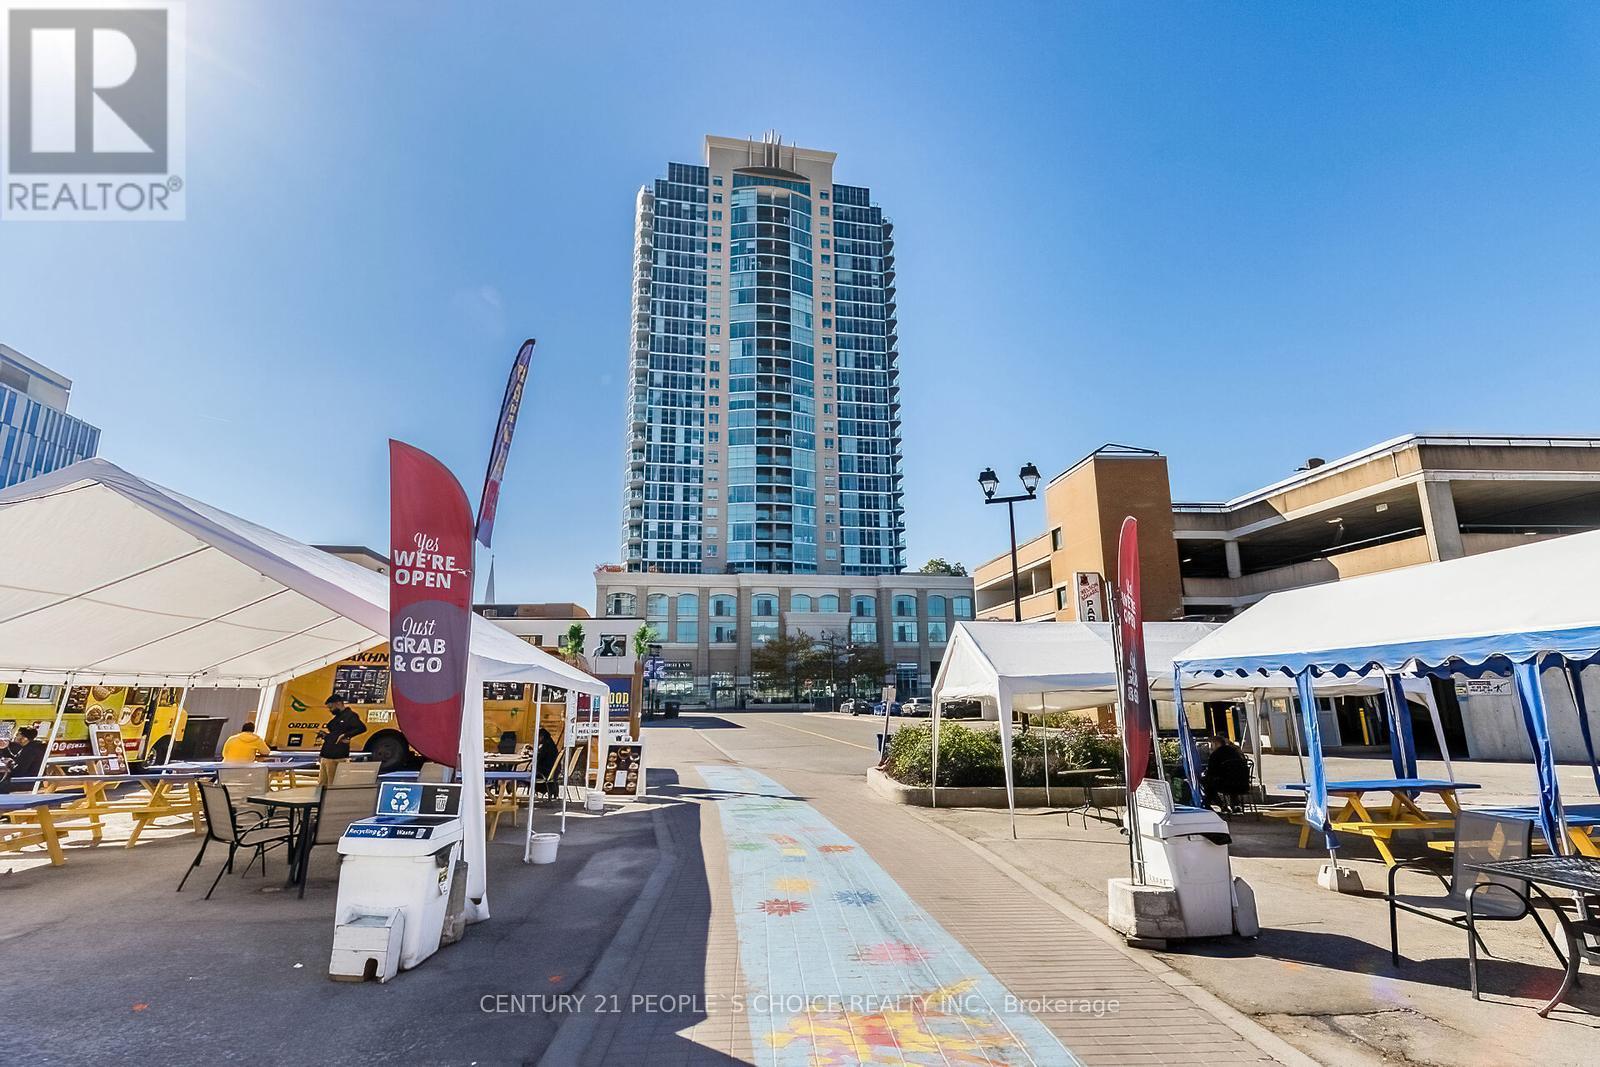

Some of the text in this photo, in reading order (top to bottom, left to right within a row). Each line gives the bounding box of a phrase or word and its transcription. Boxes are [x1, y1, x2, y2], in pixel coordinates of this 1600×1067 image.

[414, 532, 439, 553] Yes
[394, 550, 456, 571] WE'RE
[395, 568, 452, 589] OPEN
[1086, 600, 1096, 622] PAR
[402, 617, 436, 638] Just
[392, 636, 446, 655] GRAB
[348, 652, 390, 663] AKHN
[394, 655, 443, 673] & GO
[609, 692, 630, 705] OOD
[349, 828, 377, 836] Recycling
